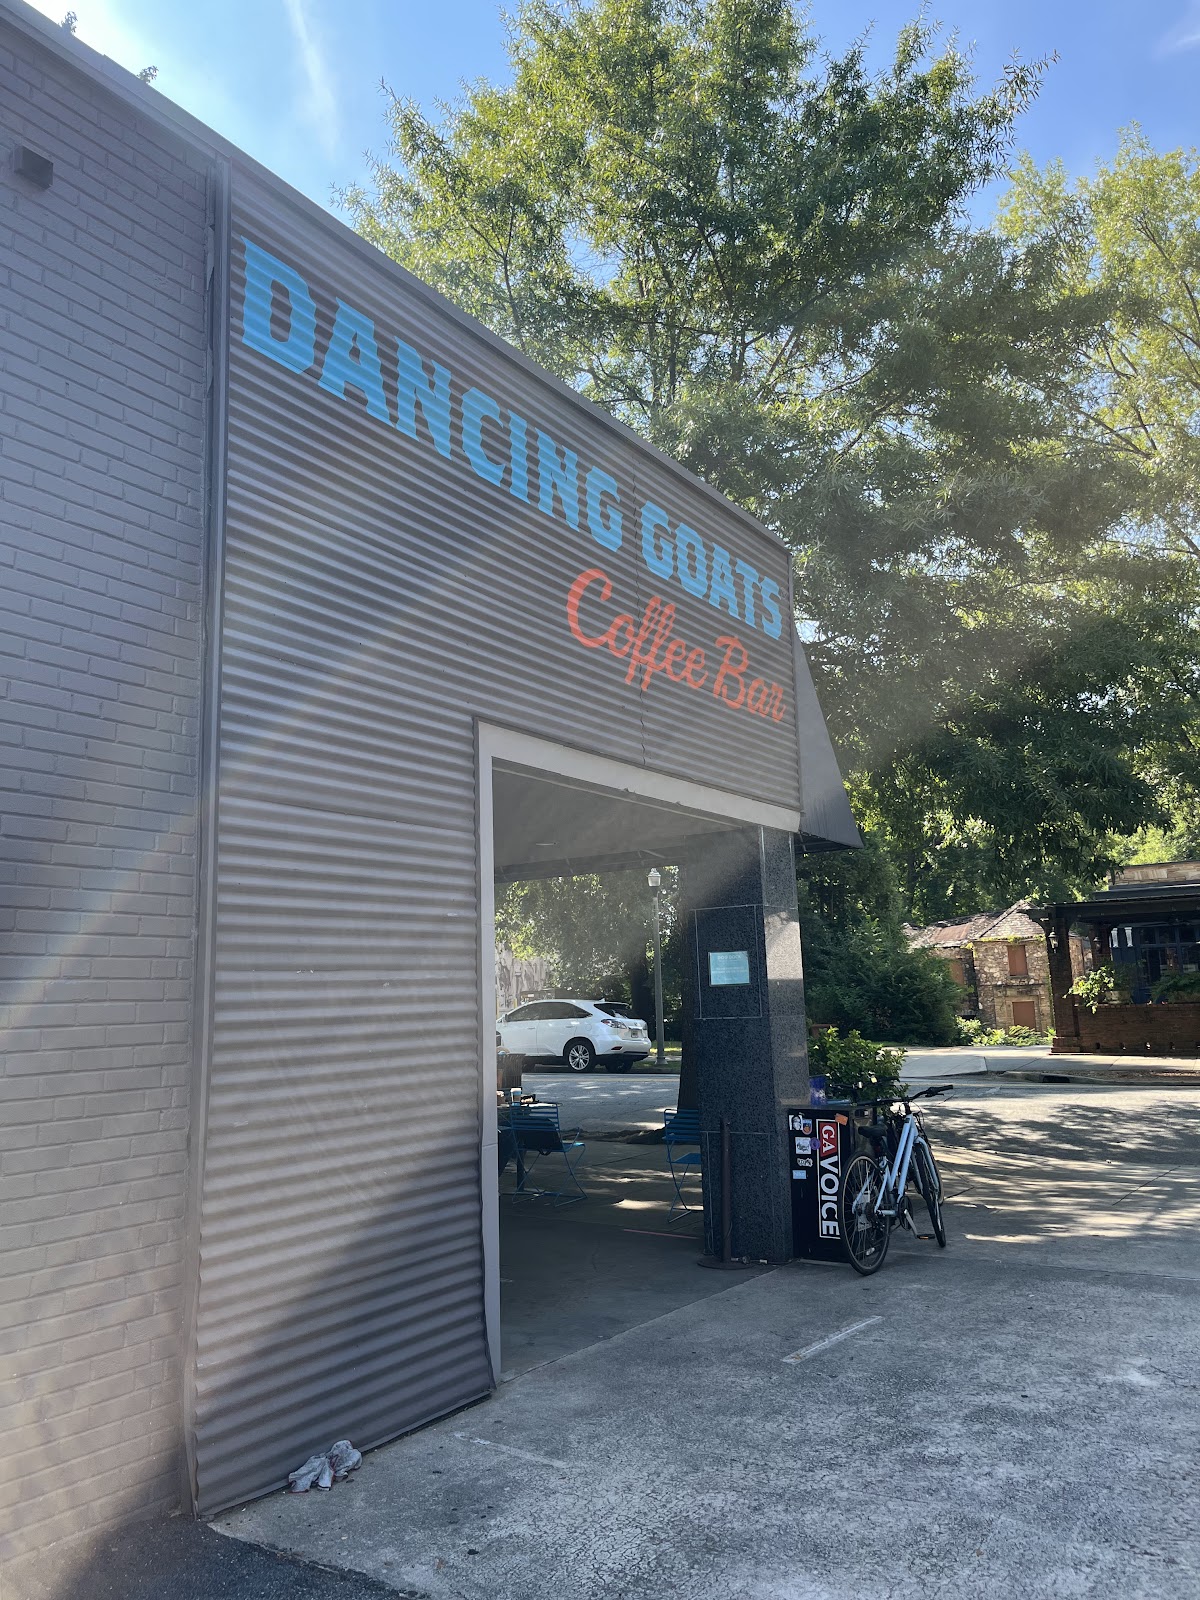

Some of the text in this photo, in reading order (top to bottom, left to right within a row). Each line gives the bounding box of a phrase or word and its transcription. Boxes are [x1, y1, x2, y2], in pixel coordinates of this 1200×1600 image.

[240, 235, 782, 640] DANCING GOATS
[566, 568, 787, 723] Coffee Bar
[820, 1125, 840, 1236] GA VOICE
